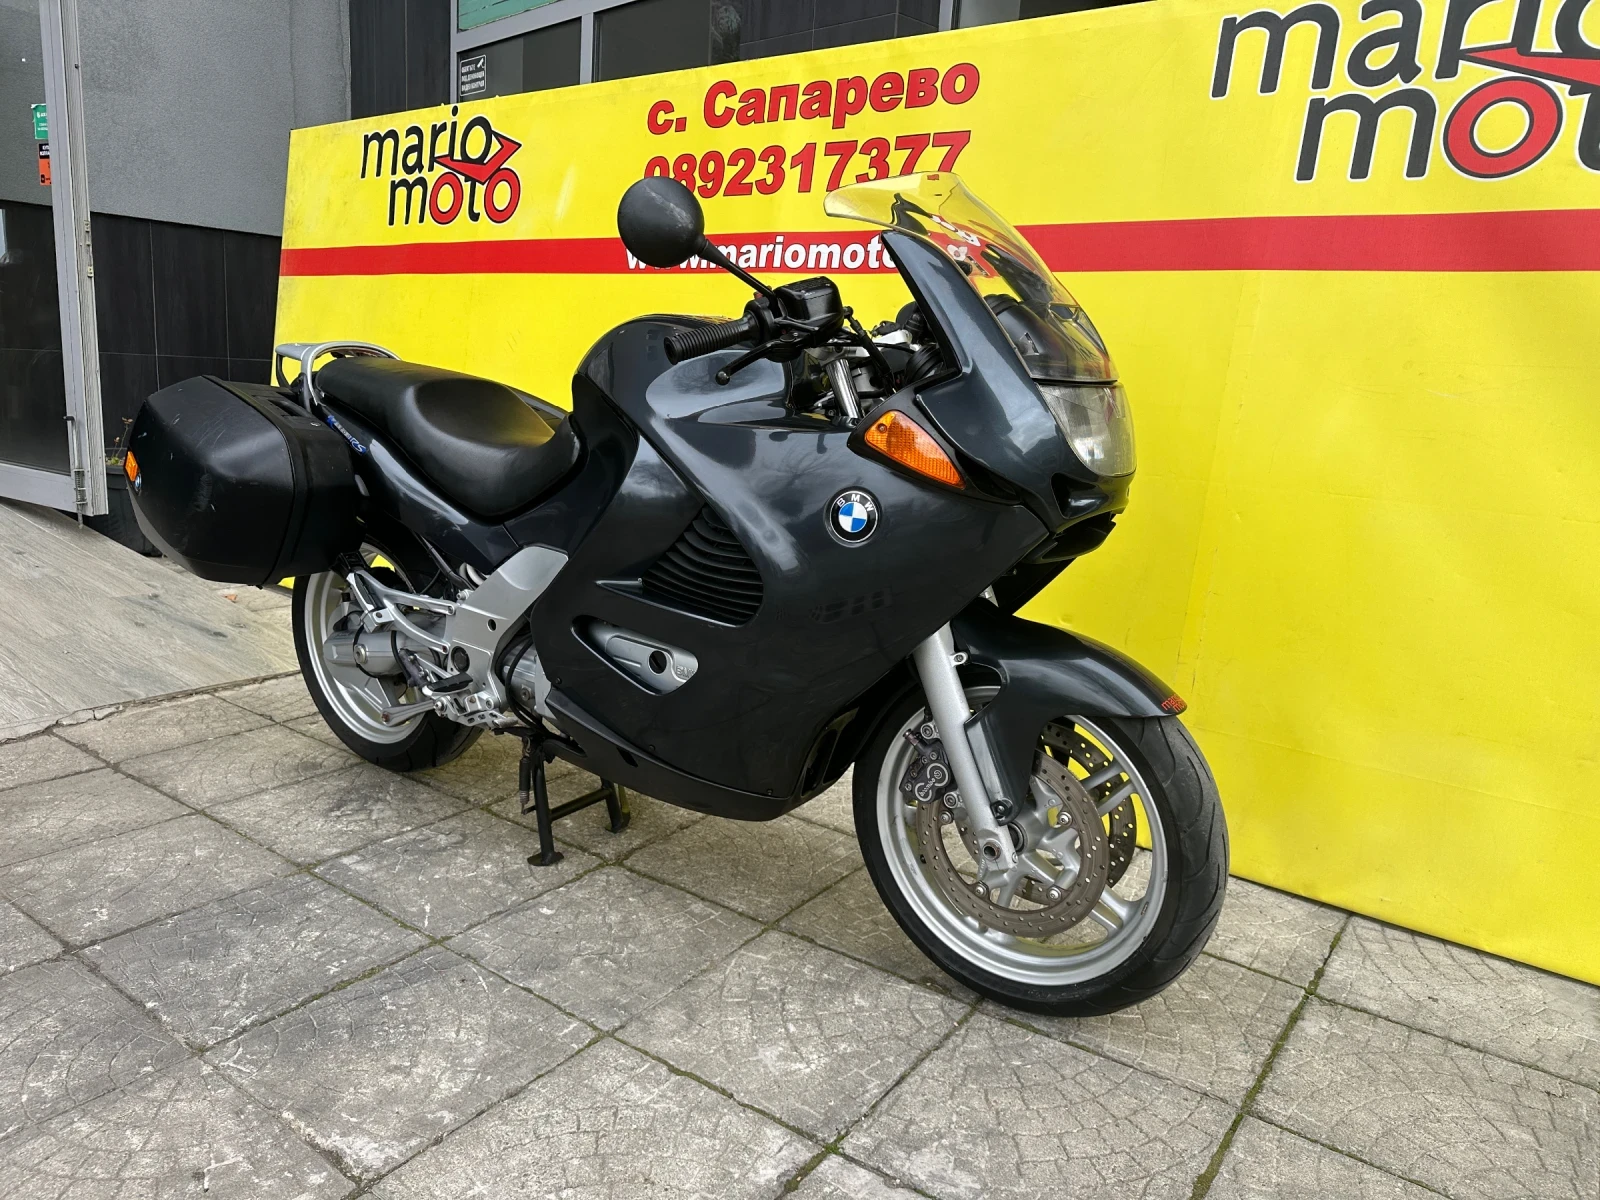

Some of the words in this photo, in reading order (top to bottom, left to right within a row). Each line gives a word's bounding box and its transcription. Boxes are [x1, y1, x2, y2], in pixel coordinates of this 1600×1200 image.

[647, 100, 687, 135] с.
[704, 62, 980, 129] Сапарево
[361, 105, 493, 178] mario
[388, 168, 521, 226] moto
[836, 493, 874, 512] BMW
